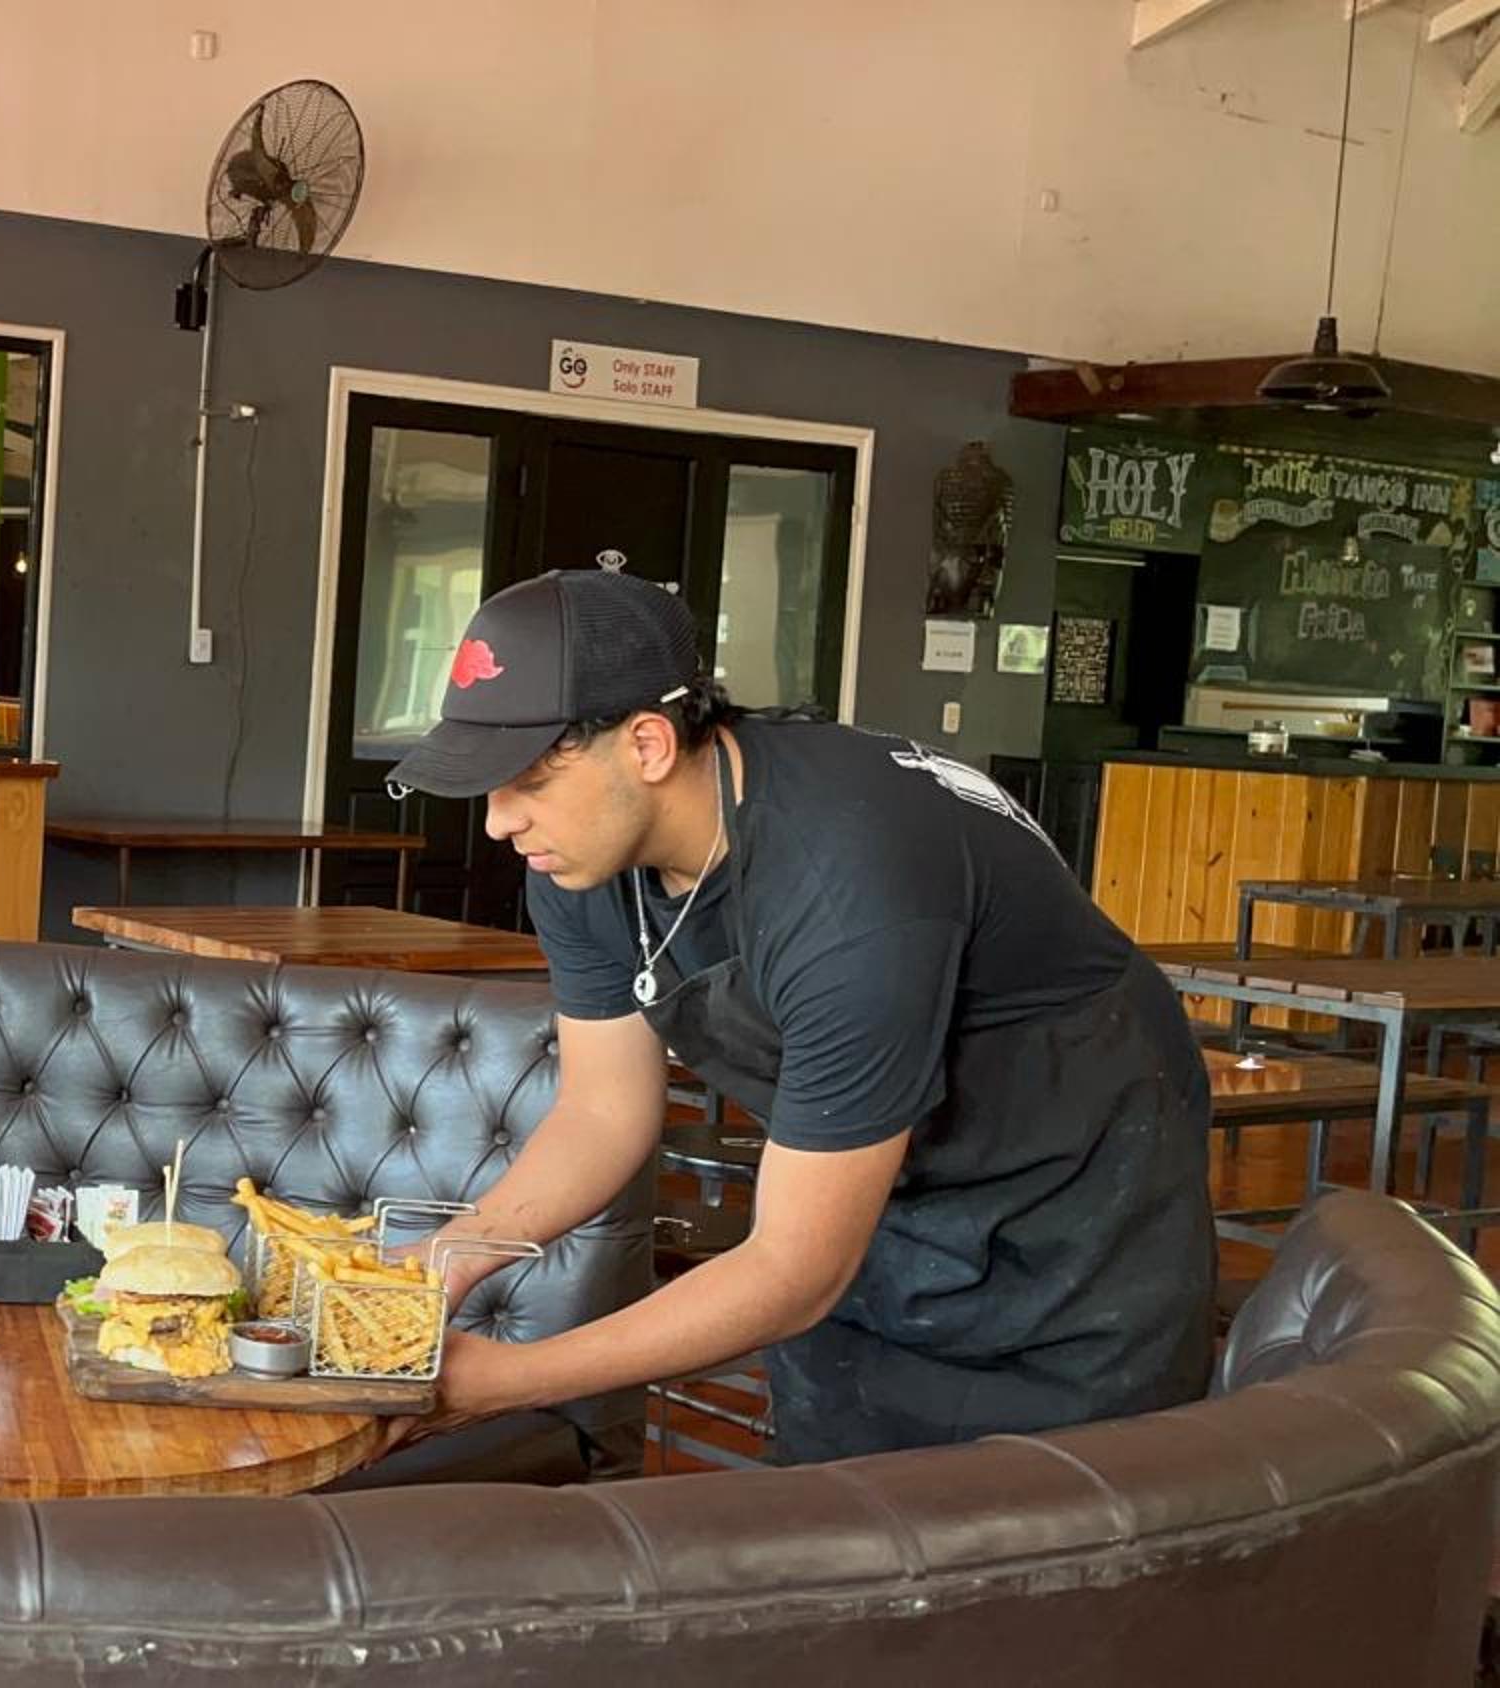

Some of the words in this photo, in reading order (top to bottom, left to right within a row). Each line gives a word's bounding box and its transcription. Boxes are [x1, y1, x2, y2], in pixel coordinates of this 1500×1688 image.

[612, 359, 640, 378] Only
[643, 363, 675, 379] STAFF
[612, 379, 638, 394] Solo
[641, 384, 673, 399] STAFF
[1085, 448, 1195, 528] HOLY
[1334, 471, 1407, 508] TANGO
[1412, 482, 1450, 514] INN
